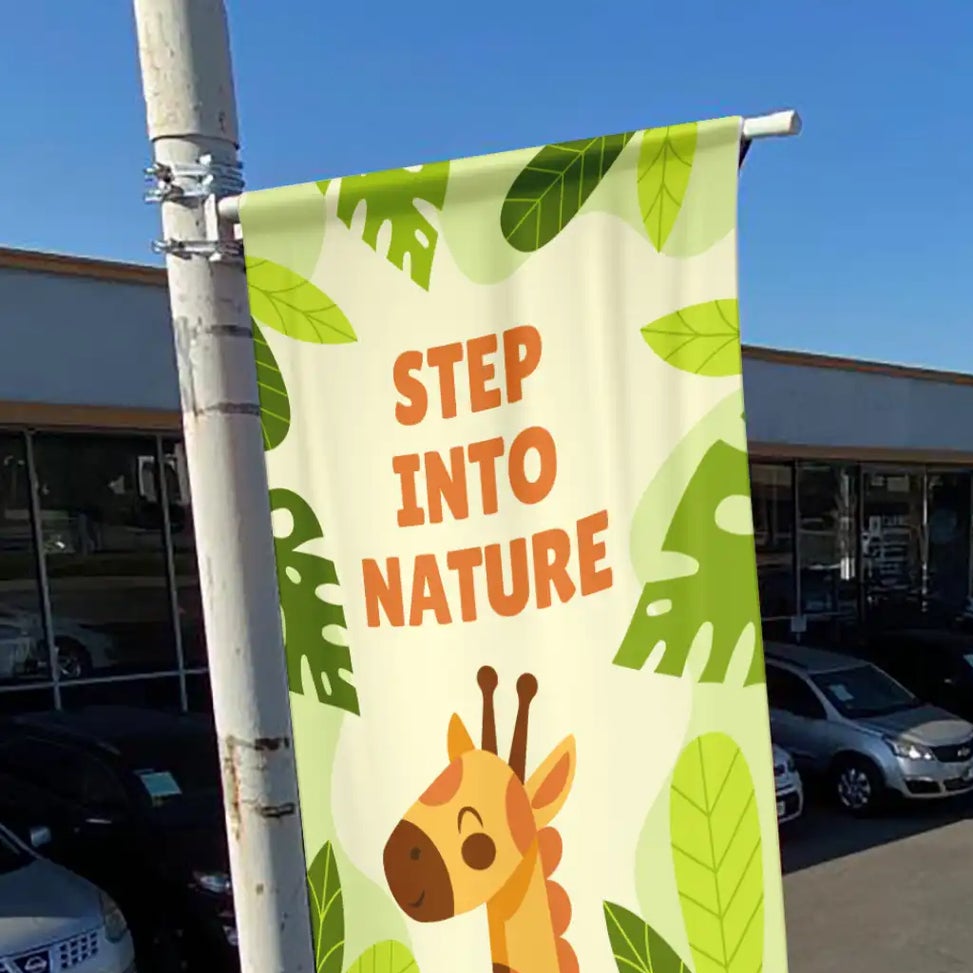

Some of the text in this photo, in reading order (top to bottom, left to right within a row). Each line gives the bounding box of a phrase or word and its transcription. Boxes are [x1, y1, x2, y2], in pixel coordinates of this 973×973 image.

[392, 325, 542, 426] STEP
[392, 426, 557, 528] INTO
[361, 509, 613, 628] NATURE
